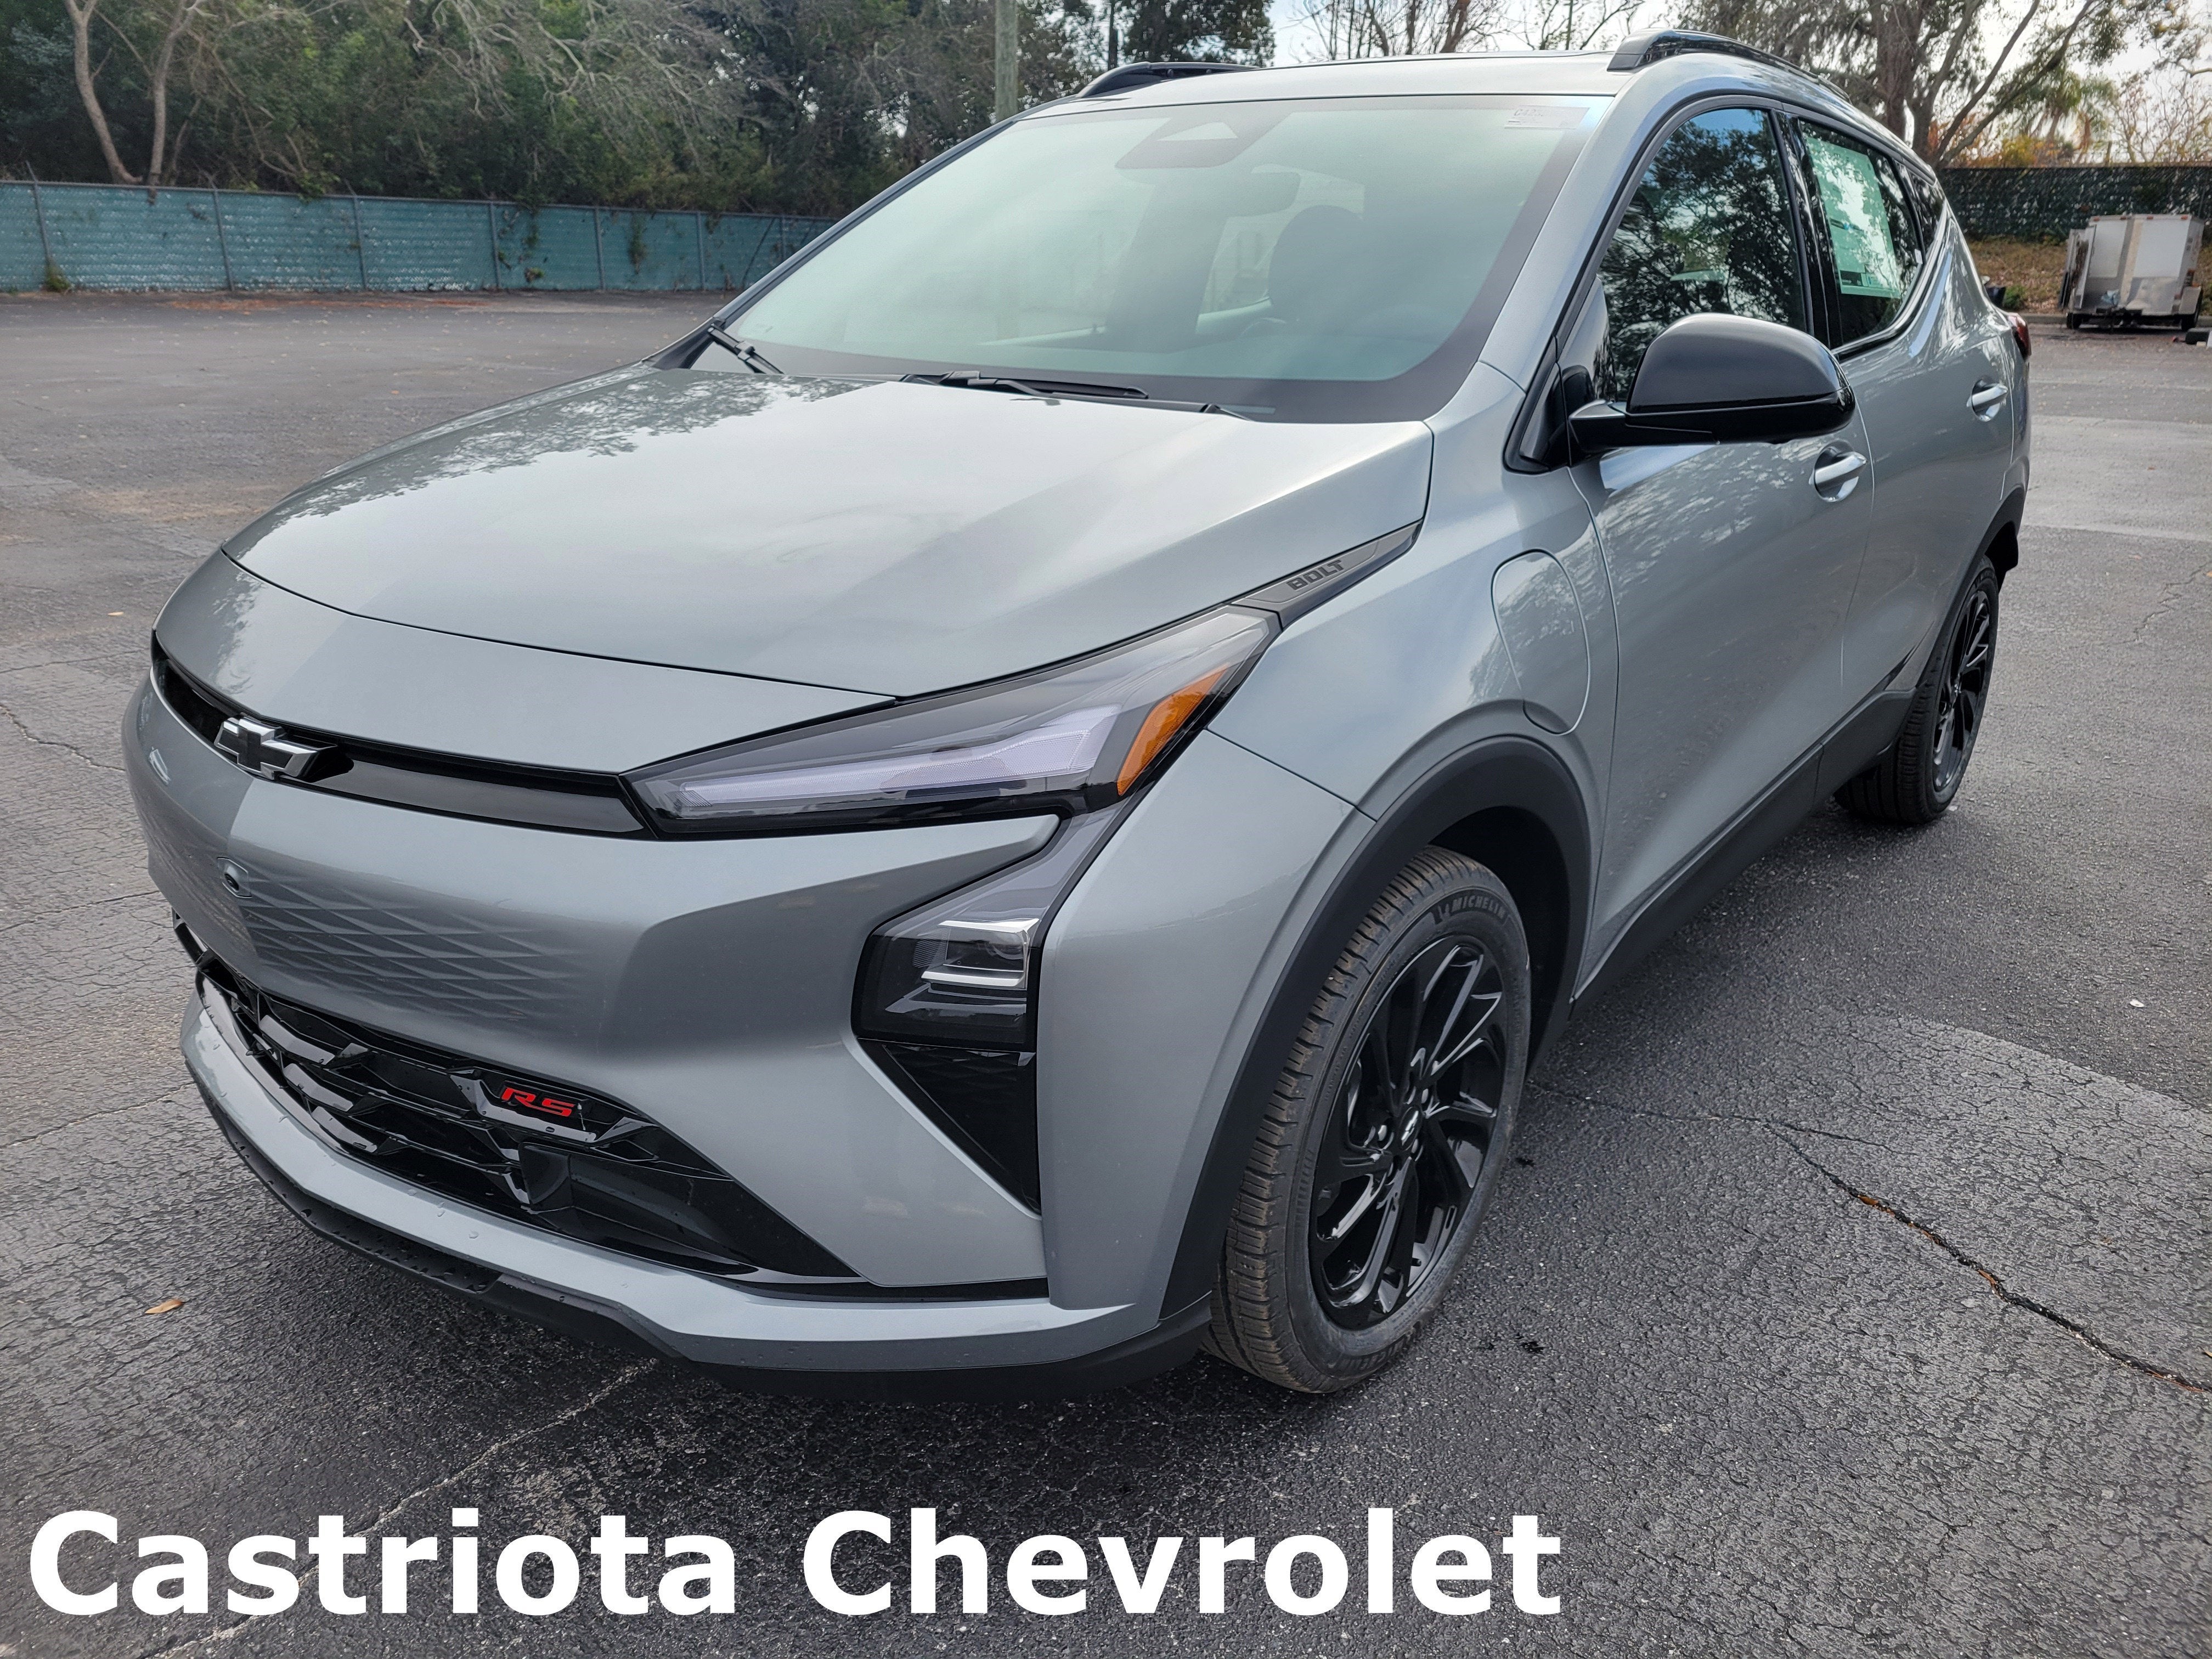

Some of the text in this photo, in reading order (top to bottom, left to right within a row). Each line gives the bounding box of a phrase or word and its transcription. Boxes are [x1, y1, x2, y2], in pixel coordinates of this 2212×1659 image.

[1286, 560, 1344, 591] BOLT
[1451, 895, 1507, 919] MICHELIN
[500, 1086, 575, 1117] RS
